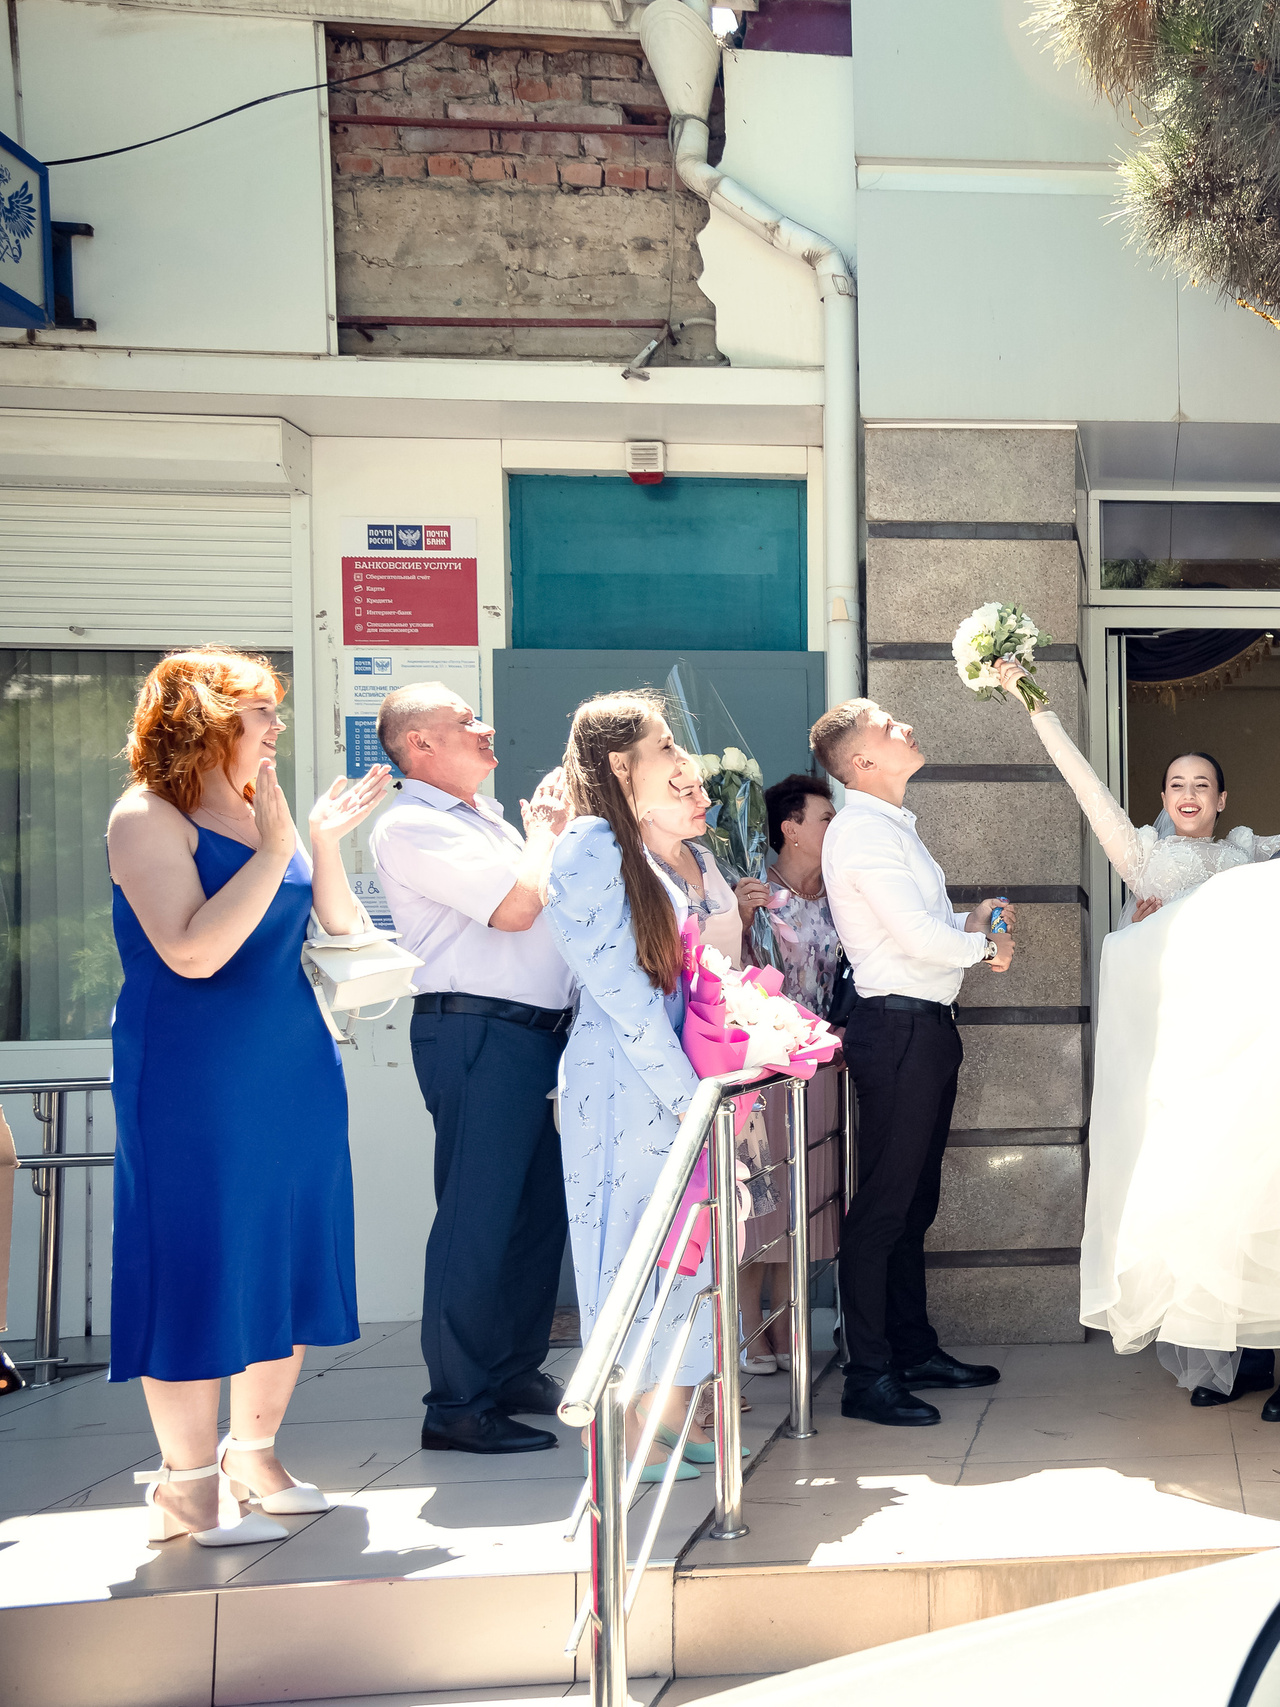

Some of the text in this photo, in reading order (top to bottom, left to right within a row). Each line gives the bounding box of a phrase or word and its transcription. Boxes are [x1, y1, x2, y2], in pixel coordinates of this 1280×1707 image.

[369, 529, 393, 537] ПОЧТА
[426, 530, 449, 538] ПОЧТА
[369, 537, 394, 545] РОССИИ
[426, 538, 447, 546] БАНК
[354, 561, 462, 571] БАНКОВСКИЕ УСЛУГИ
[365, 573, 416, 581] Сберегательный
